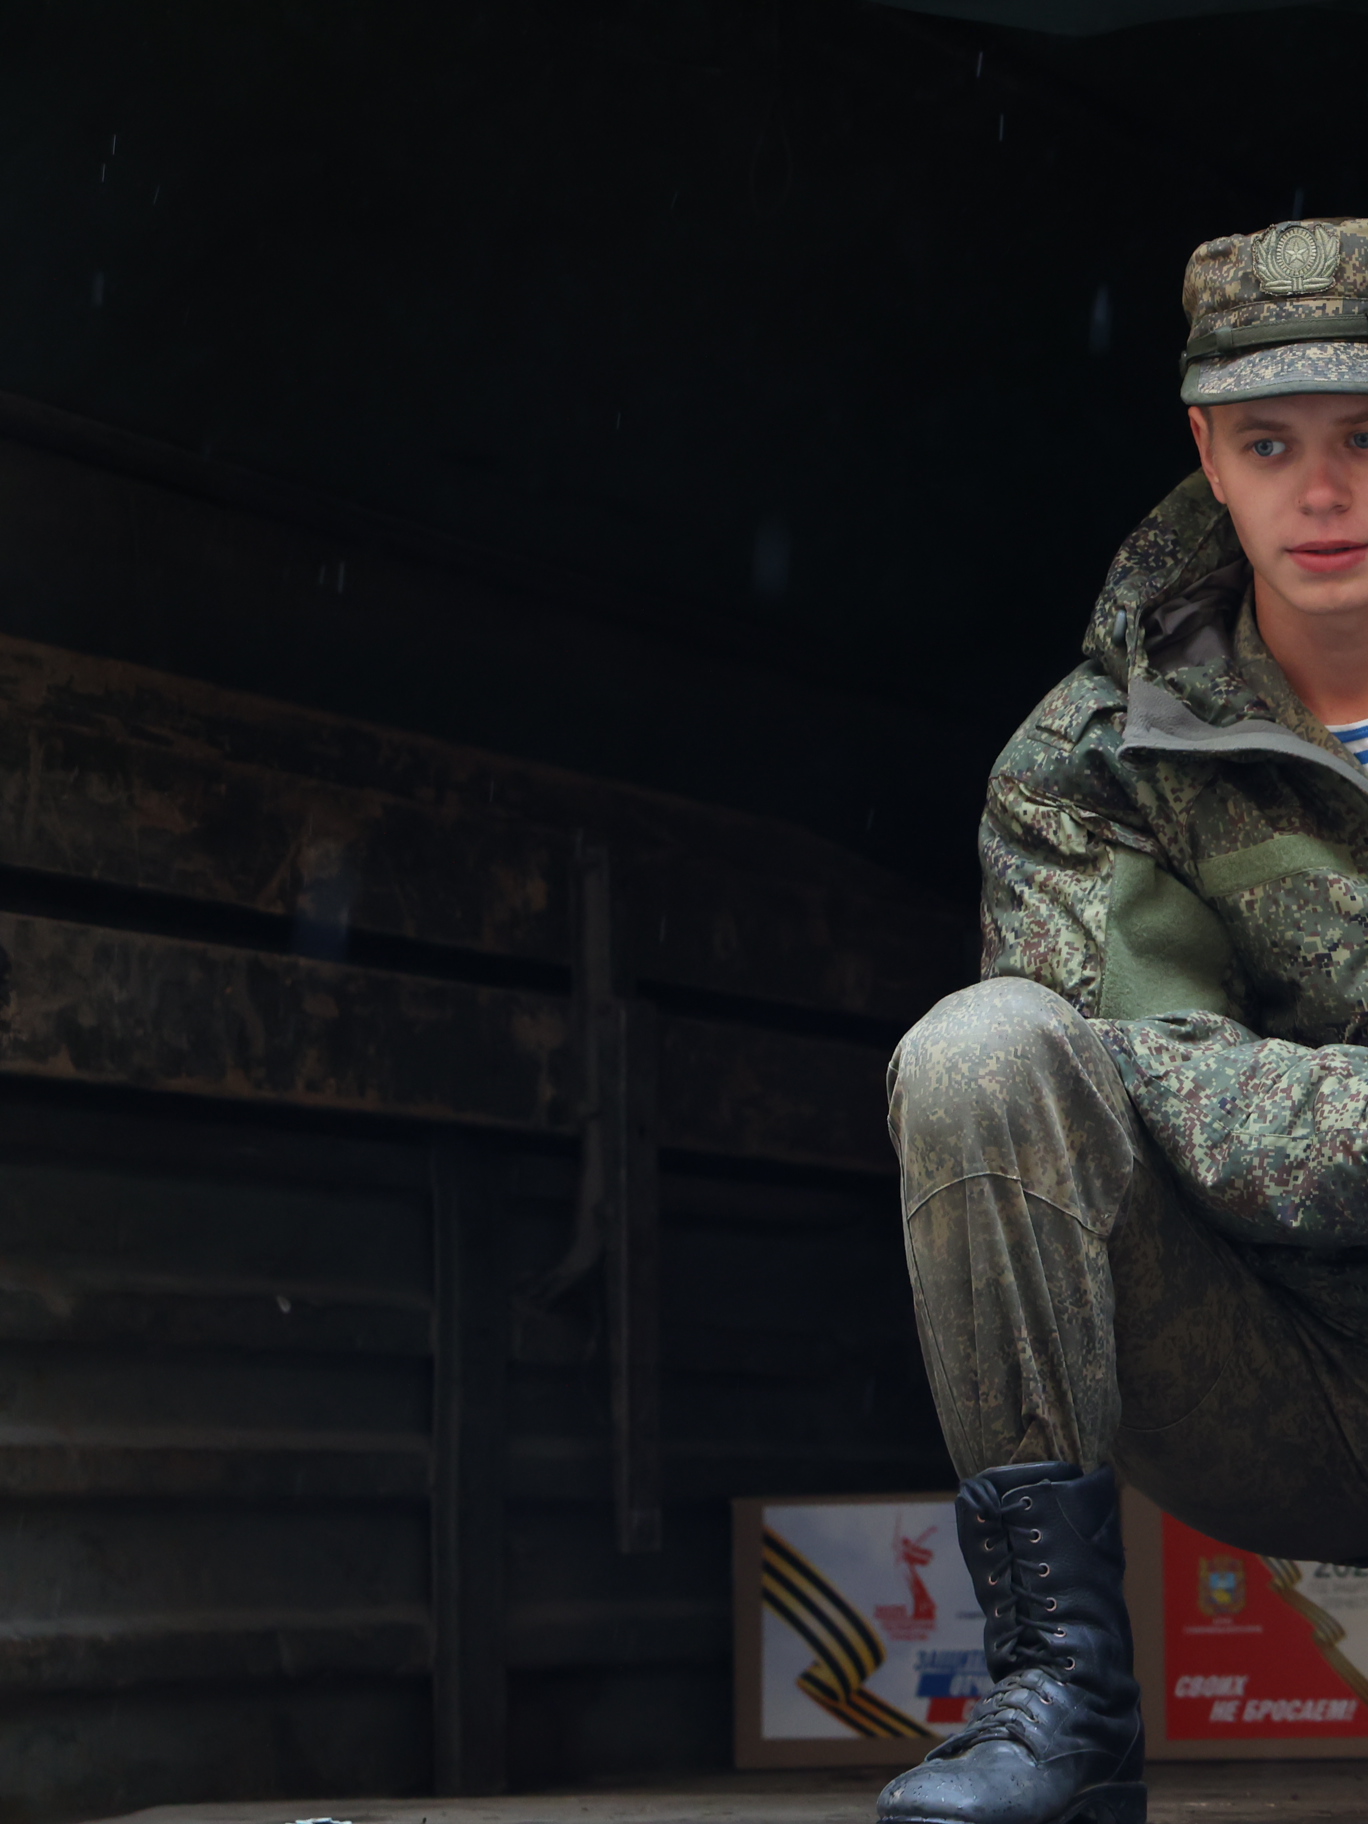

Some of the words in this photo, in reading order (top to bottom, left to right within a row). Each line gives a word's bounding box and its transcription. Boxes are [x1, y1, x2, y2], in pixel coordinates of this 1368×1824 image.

[1174, 1674, 1250, 1698] СВОИХ
[1208, 1700, 1241, 1723] НЕ
[1243, 1698, 1359, 1723] БРОСАЕМ!
